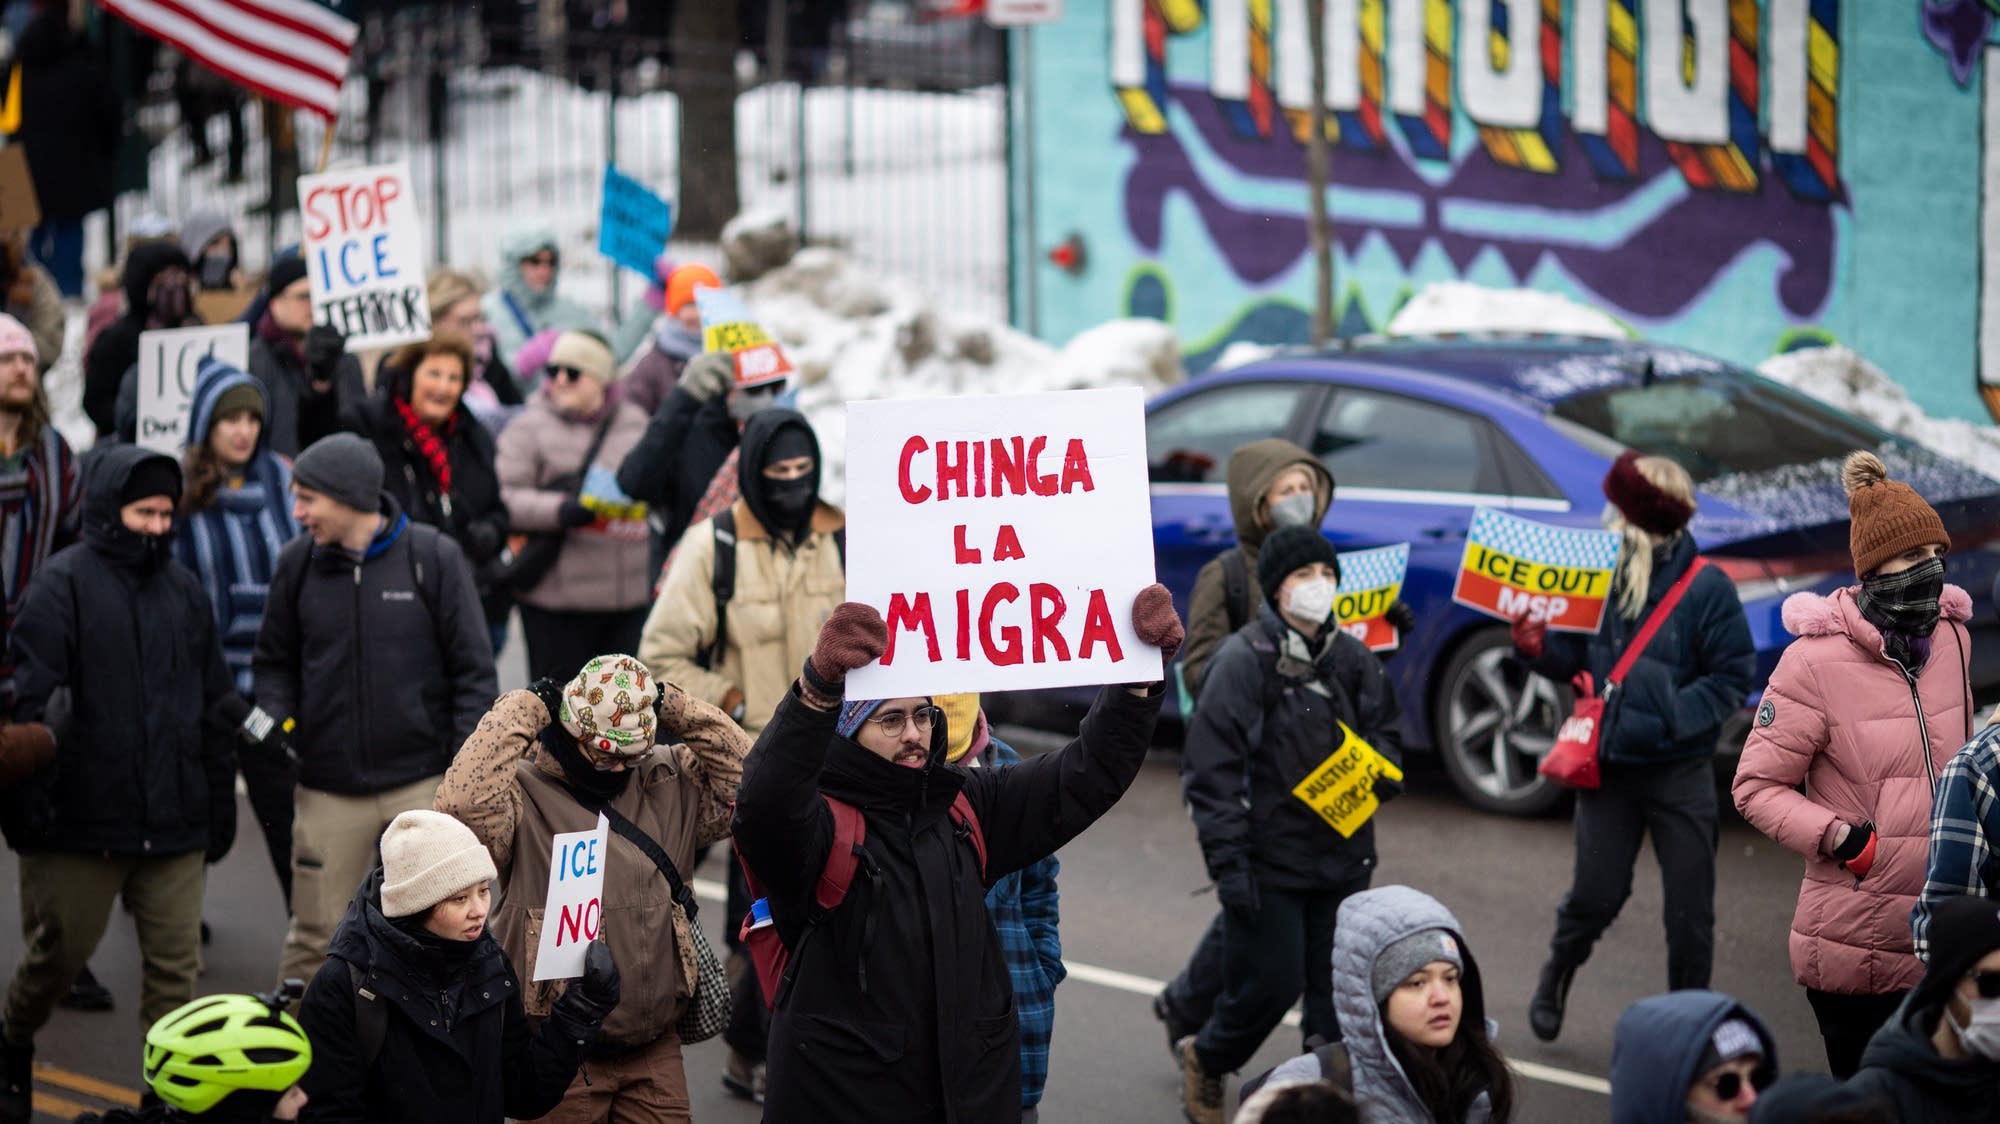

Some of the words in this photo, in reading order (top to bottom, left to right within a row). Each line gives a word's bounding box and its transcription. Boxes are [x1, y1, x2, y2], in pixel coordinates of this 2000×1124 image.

[306, 176, 400, 241] STOP
[319, 234, 398, 292] ICE
[157, 336, 230, 400] IC
[898, 435, 1095, 505] CHINGA
[953, 524, 1026, 565] LA
[1477, 549, 1532, 586] ICE
[1537, 567, 1601, 594] OUT
[878, 581, 1125, 667] MIGRA
[1337, 587, 1392, 620] OUT
[1496, 586, 1570, 624] MSP
[559, 838, 598, 882] ICE
[555, 897, 600, 948] NO
